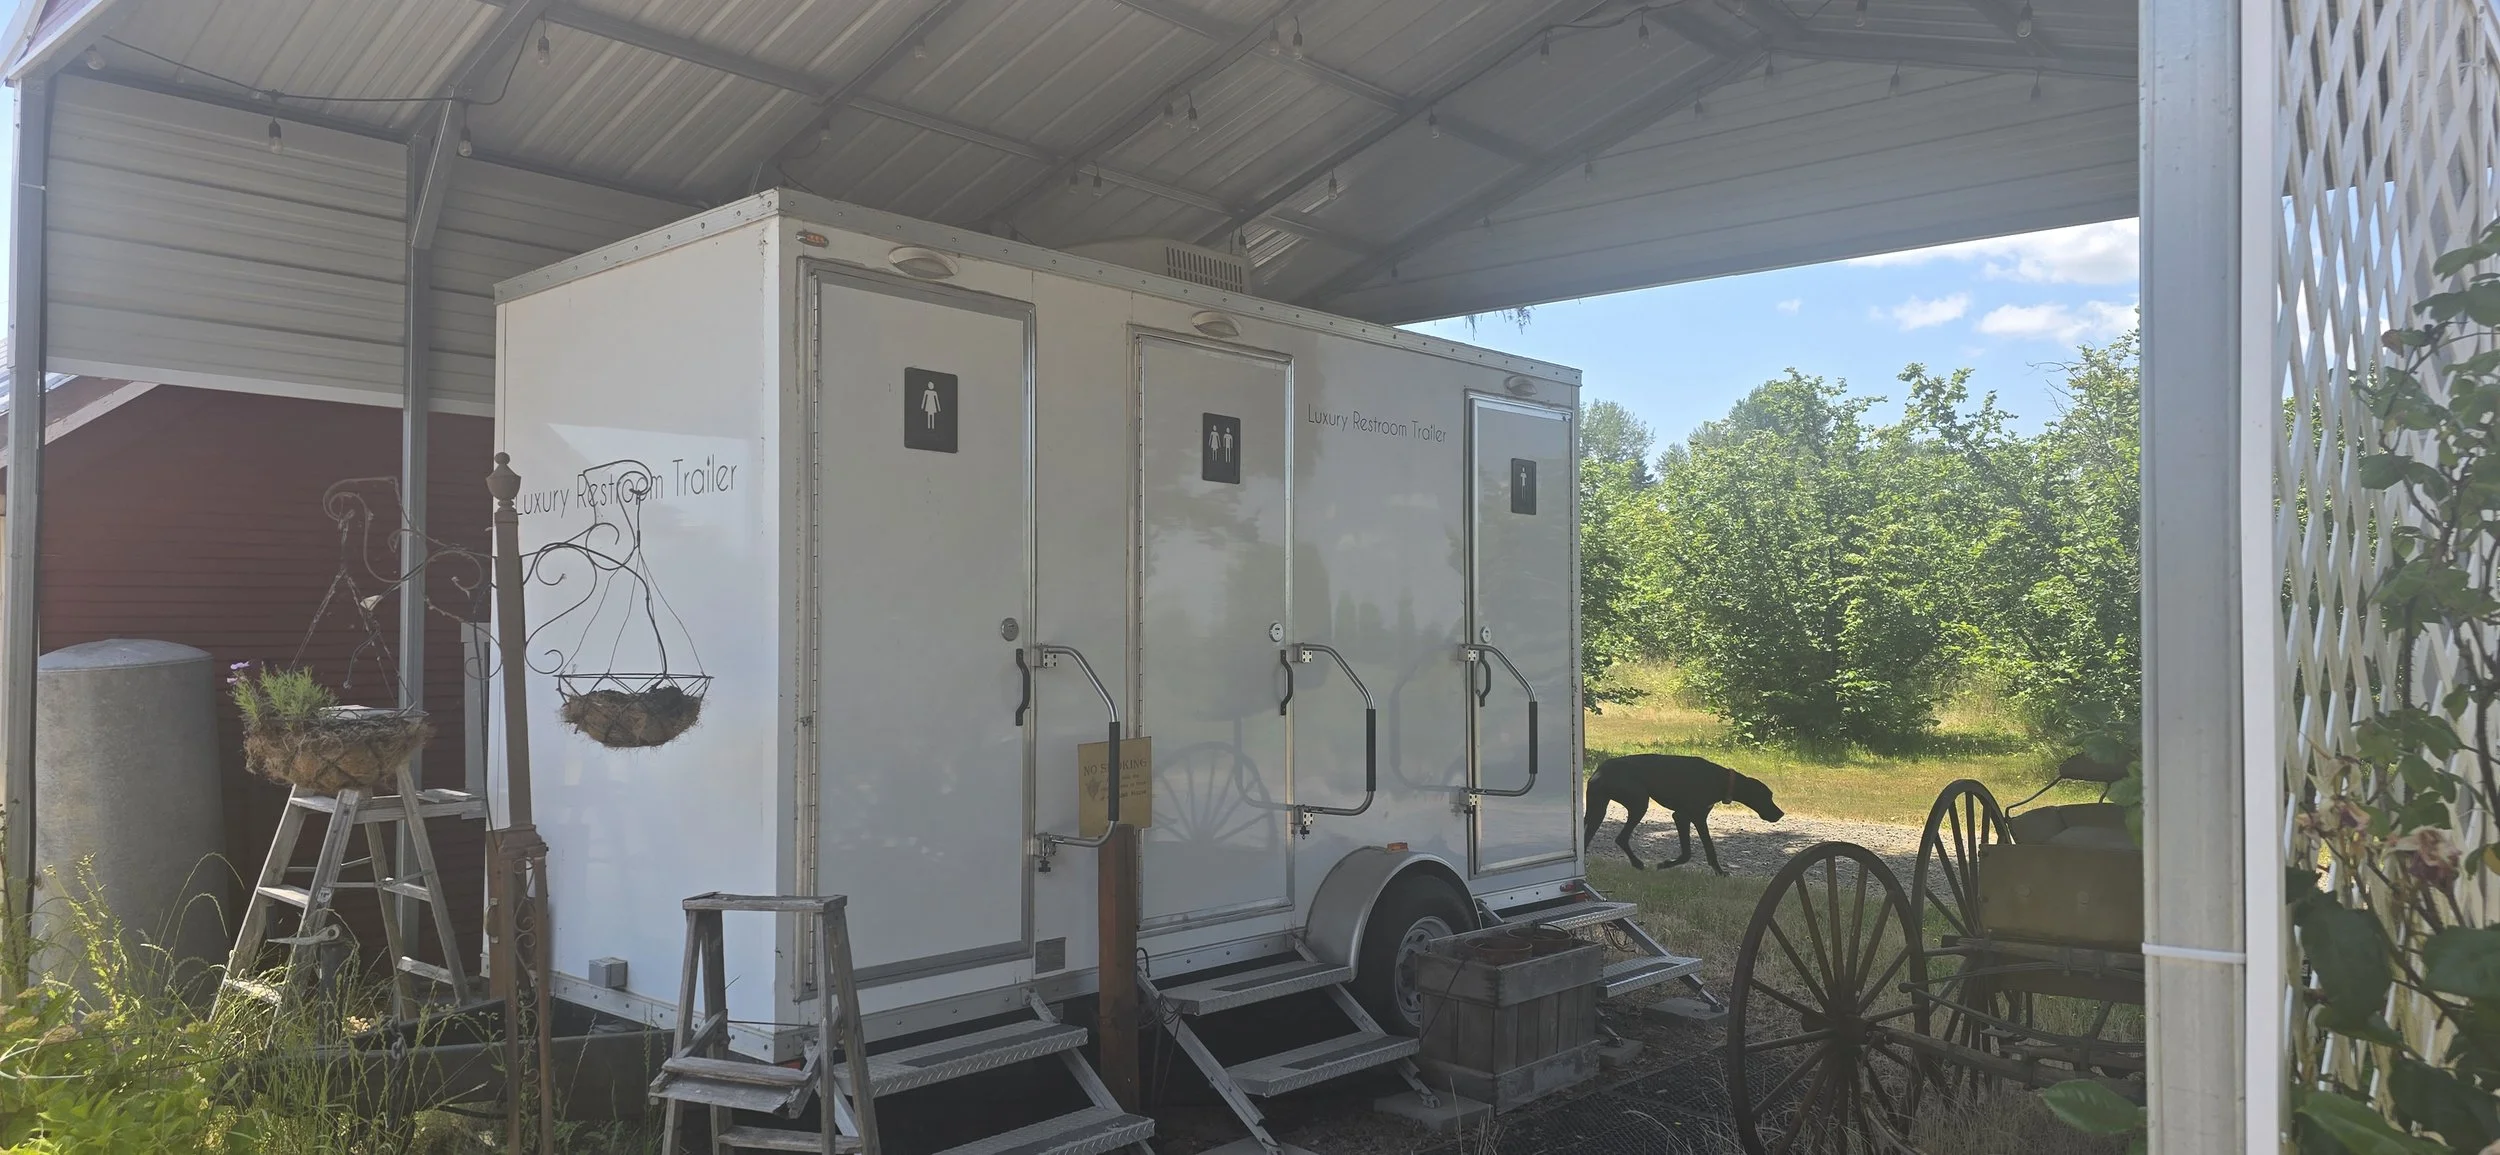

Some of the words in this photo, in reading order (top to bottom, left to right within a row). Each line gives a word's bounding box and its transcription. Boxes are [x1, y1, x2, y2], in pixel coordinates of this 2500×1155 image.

[1308, 403, 1348, 431] Luxury
[1353, 410, 1408, 437] Restroom
[1412, 420, 1447, 443] Trailer
[577, 473, 664, 508] Restroom
[672, 454, 738, 496] Trailer
[1083, 764, 1098, 777] NO
[1100, 758, 1147, 773] SKING
